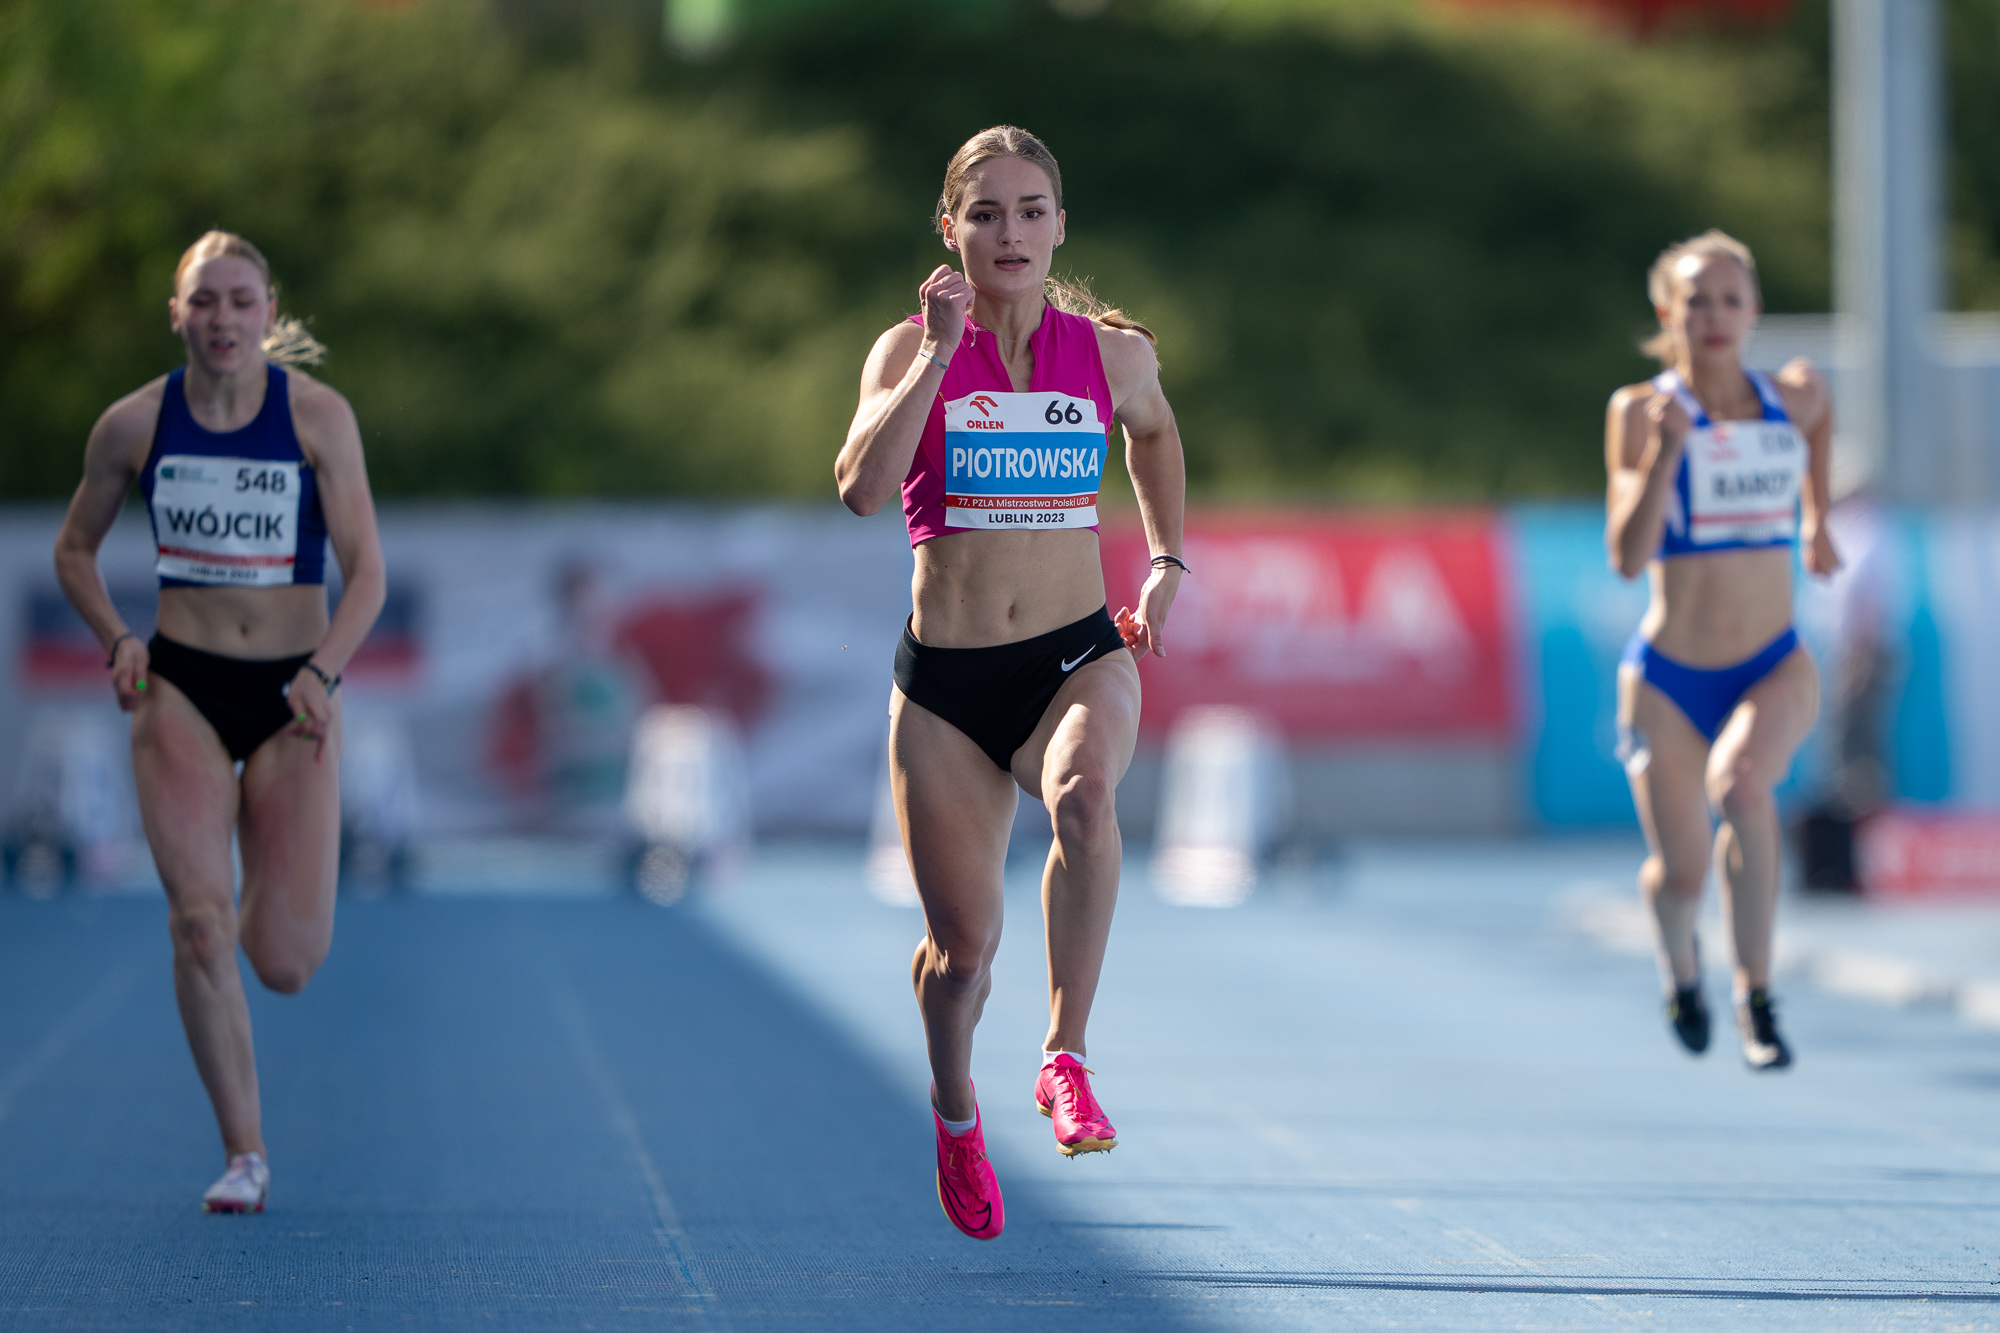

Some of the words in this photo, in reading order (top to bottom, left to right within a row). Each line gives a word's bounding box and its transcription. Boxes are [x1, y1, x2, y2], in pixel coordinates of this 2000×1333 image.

[966, 419, 1004, 430] ORLEN
[1044, 399, 1083, 425] 66
[952, 447, 1099, 479] PIOTROWSKA
[235, 467, 287, 494] 548
[957, 497, 971, 507] 77.
[972, 498, 994, 508] PZLA
[996, 498, 1051, 508] Mistrzostwa
[1052, 498, 1076, 508] Polski
[1076, 496, 1090, 506] U20
[166, 505, 285, 540] WÓJCIK
[988, 513, 1033, 524] LUBLIN
[1036, 513, 1065, 523] 2023
